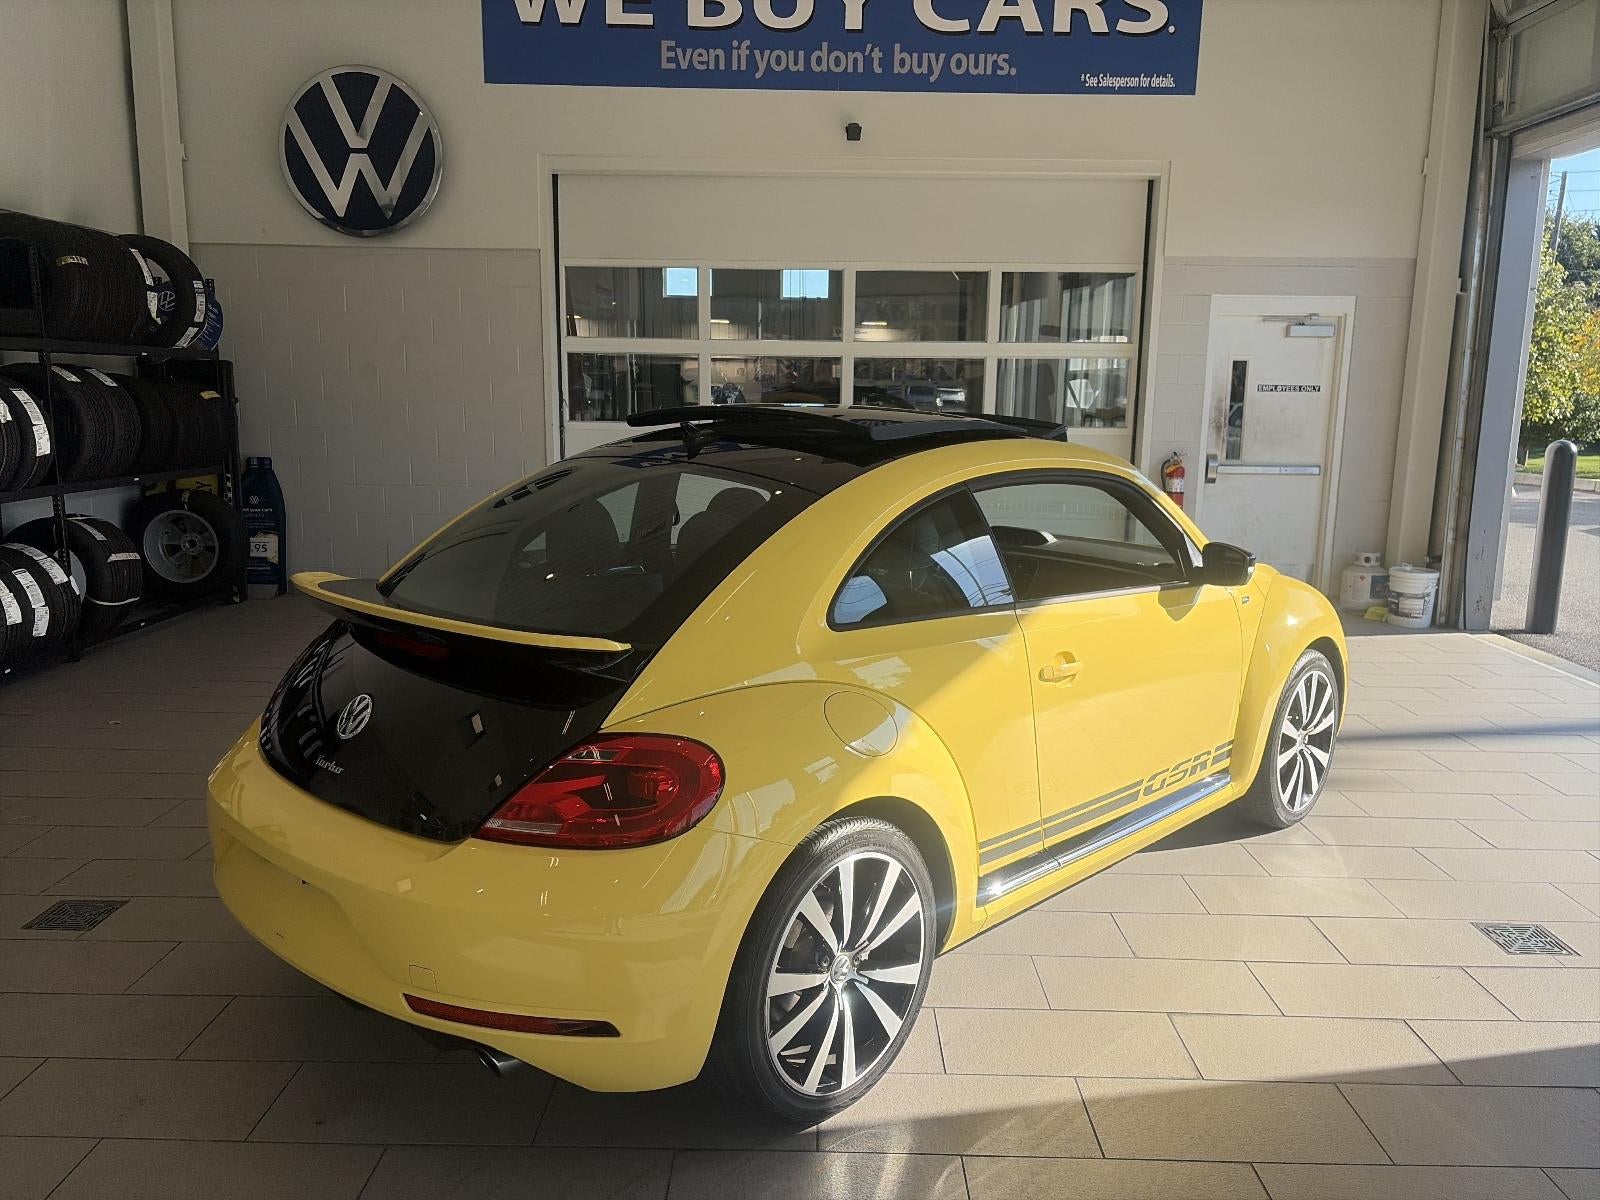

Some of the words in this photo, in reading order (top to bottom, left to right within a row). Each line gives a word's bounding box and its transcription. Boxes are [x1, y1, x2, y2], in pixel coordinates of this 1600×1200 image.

[661, 40, 725, 70] Even
[731, 39, 750, 71] if
[754, 50, 805, 79] you
[810, 42, 882, 74] don't
[893, 43, 945, 83] buy
[950, 52, 1016, 76] ours.
[1085, 73, 1098, 87] See
[1099, 73, 1139, 90] Salesperson
[1140, 73, 1150, 87] for
[1151, 73, 1175, 88] details.
[1258, 384, 1299, 392] EMPLOYEES
[1301, 384, 1320, 392] ONLY
[315, 754, 345, 774] Turbo
[1143, 750, 1212, 796] GSR
